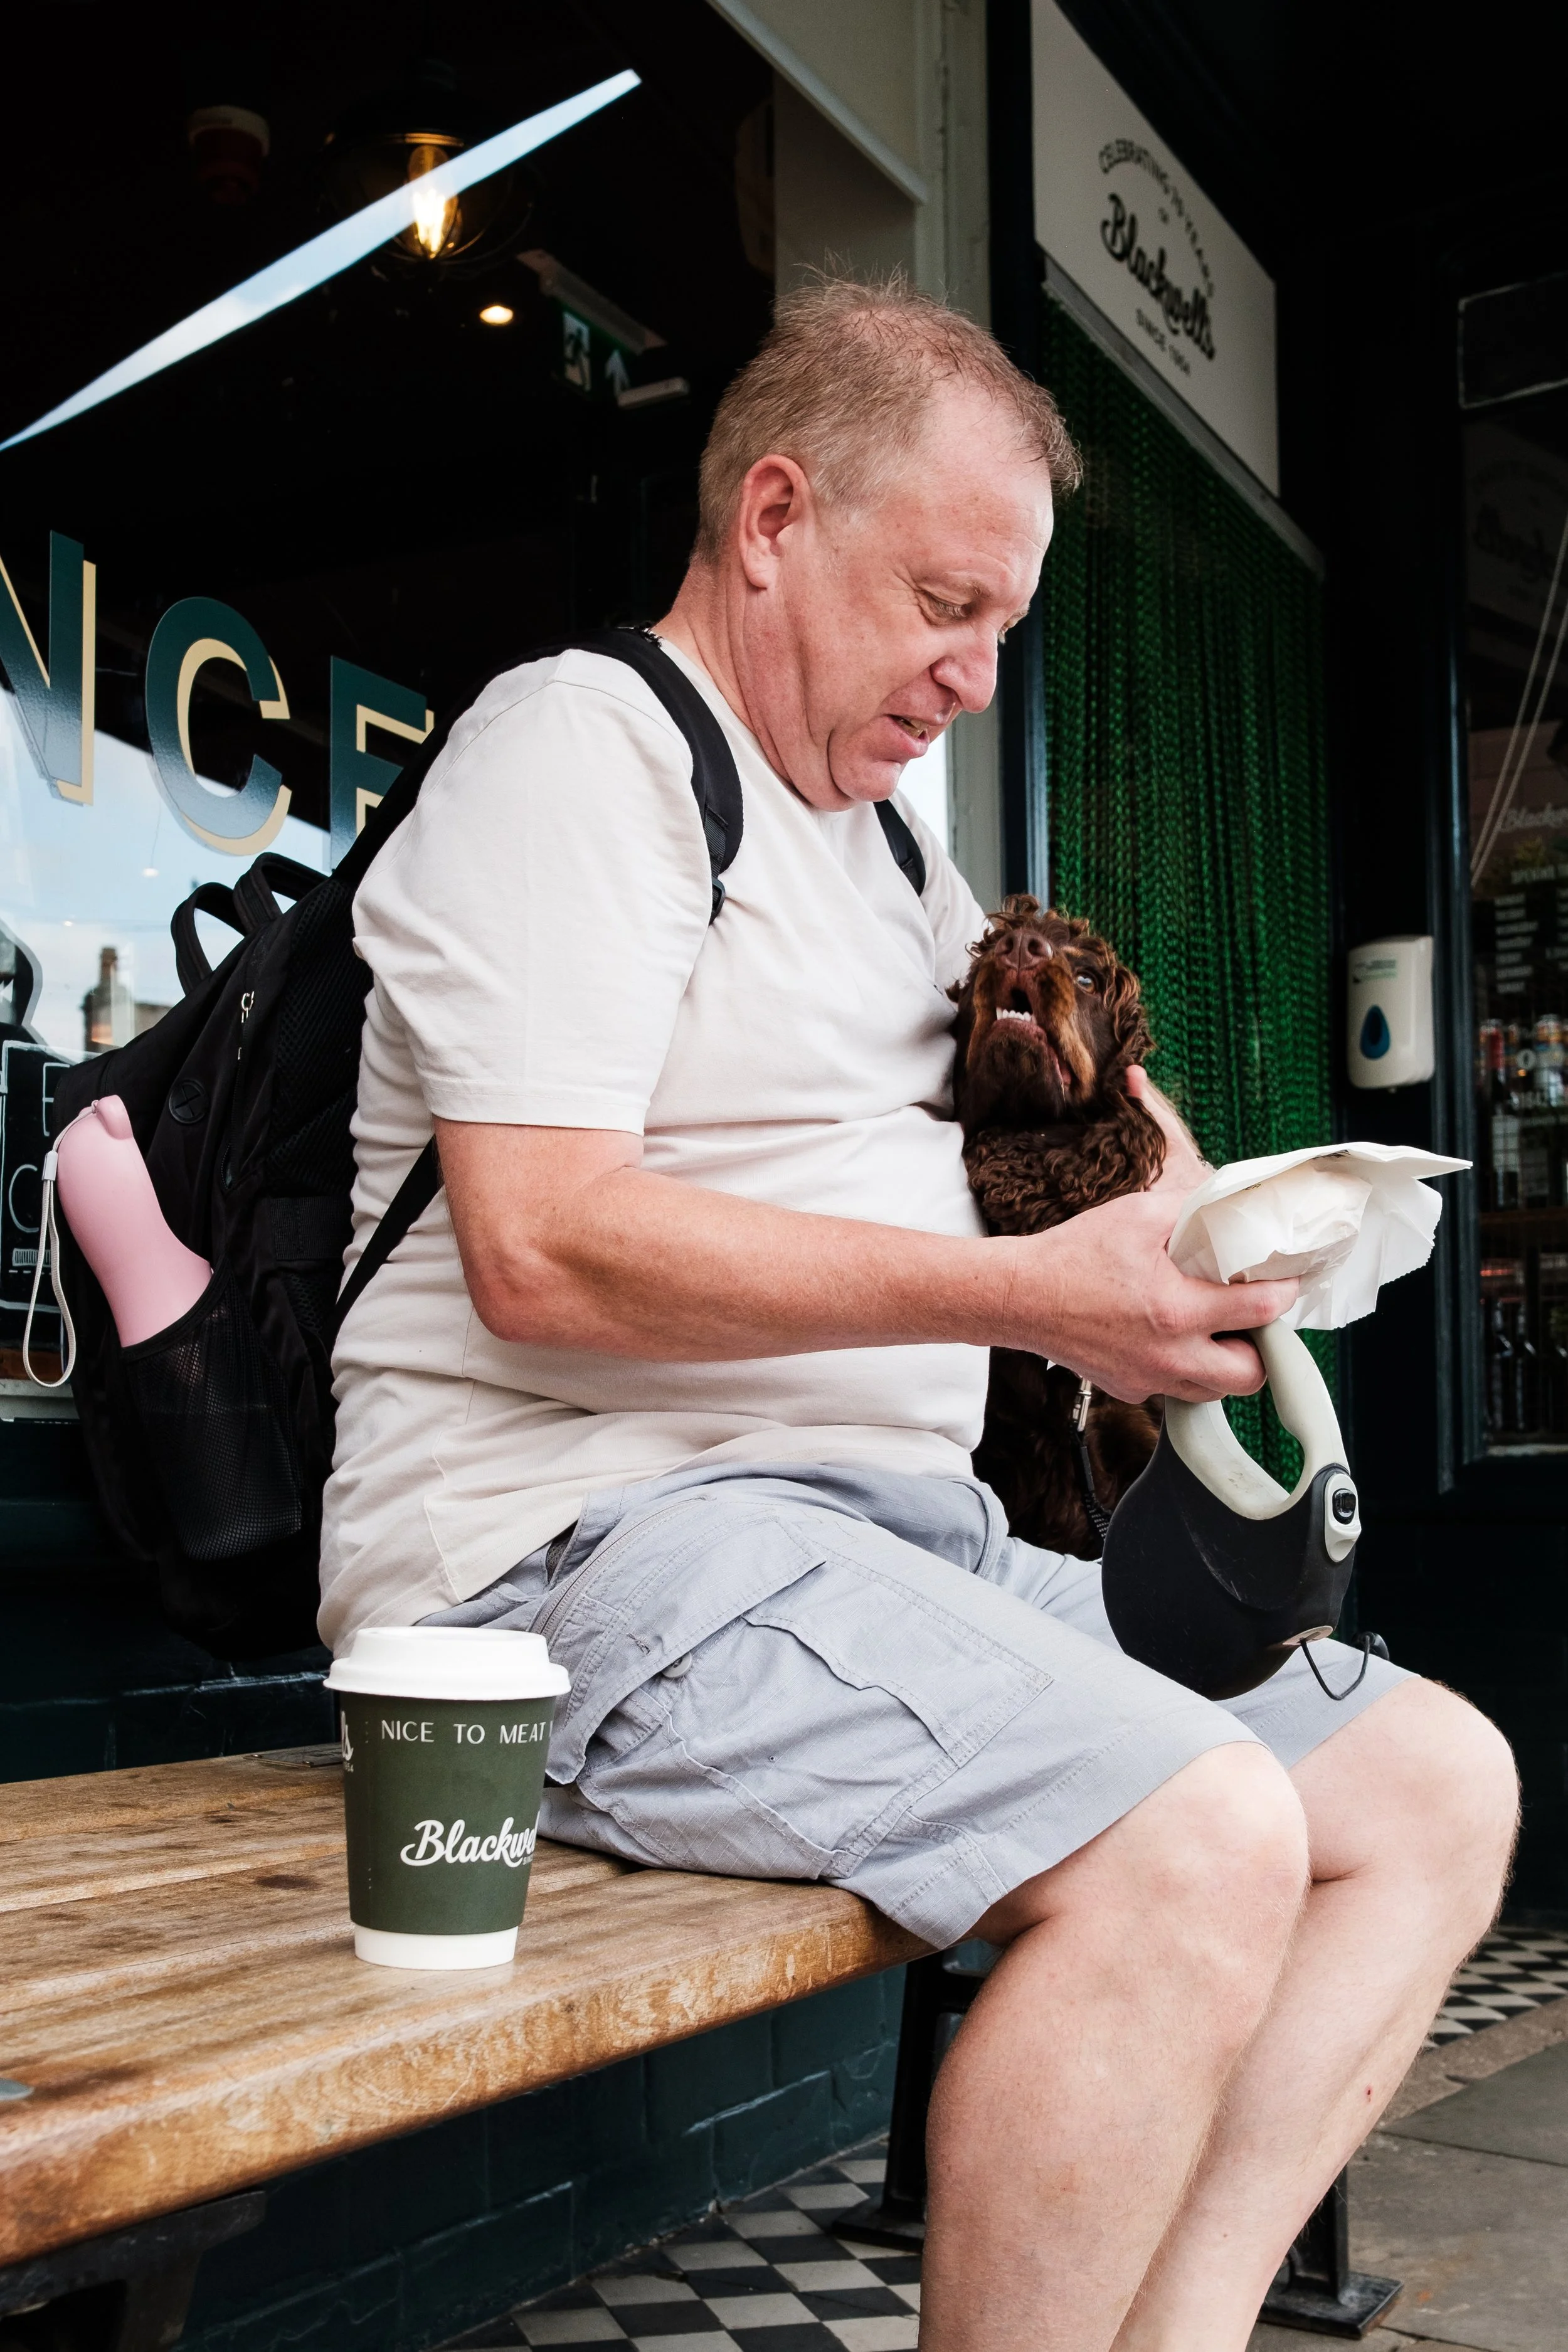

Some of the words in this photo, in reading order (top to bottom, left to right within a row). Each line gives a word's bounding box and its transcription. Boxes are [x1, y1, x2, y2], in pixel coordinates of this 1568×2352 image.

[381, 1720, 435, 1742] NICE
[453, 1724, 485, 1744] TO
[500, 1722, 546, 1744] MEAT
